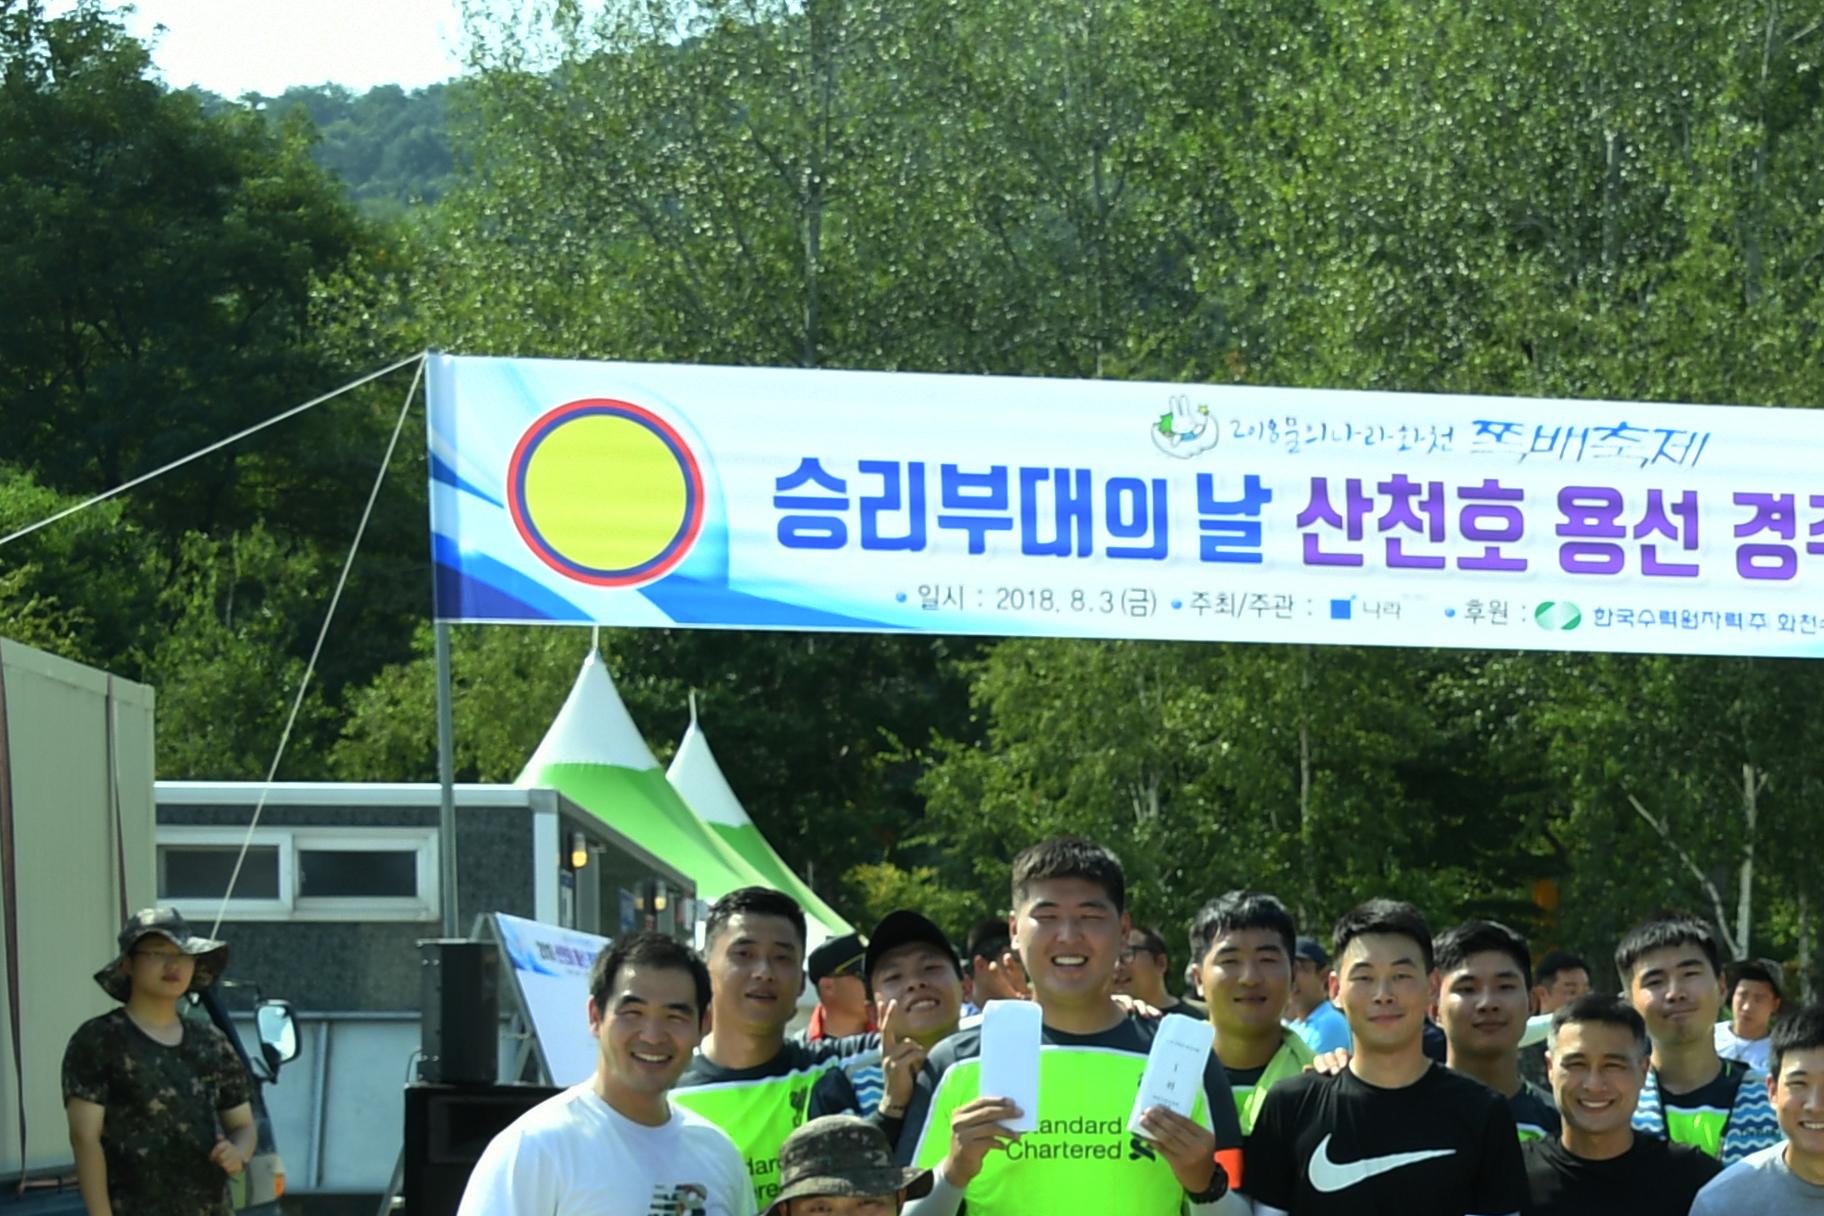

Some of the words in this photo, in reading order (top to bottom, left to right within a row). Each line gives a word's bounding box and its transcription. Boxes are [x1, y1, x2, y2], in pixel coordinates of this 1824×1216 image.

[773, 456, 1169, 561] 승리부대의
[1196, 472, 1273, 565] 날
[1296, 473, 1528, 572] 산천호
[1555, 485, 1699, 577] 용선
[918, 584, 964, 611] 일시
[996, 587, 1060, 613] 2018.
[1189, 591, 1295, 620] 주최/주관
[1464, 599, 1509, 626] 후원
[1006, 1139, 1121, 1160] Chartered
